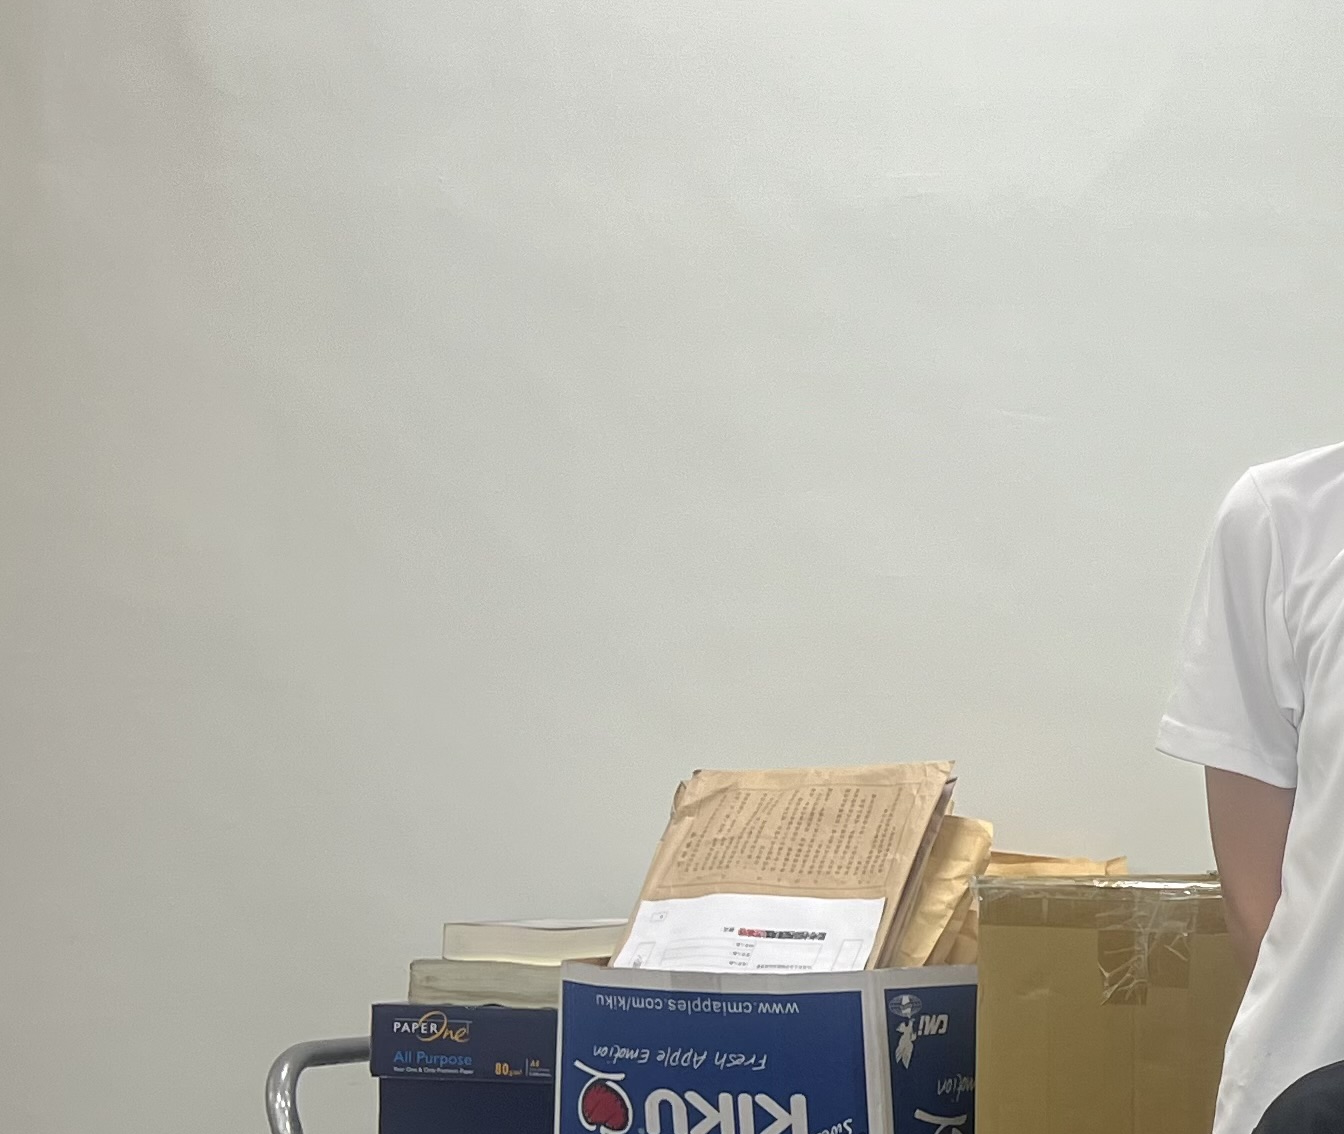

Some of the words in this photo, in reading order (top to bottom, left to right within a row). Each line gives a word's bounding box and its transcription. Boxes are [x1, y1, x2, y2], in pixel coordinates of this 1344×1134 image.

[596, 994, 800, 1016] www.cmiapples.com/kiku
[393, 1051, 412, 1064] All
[416, 1051, 473, 1067] Purpose
[593, 1044, 650, 1065] Emotion
[656, 1046, 707, 1070] Apple
[714, 1053, 767, 1071] Fresh
